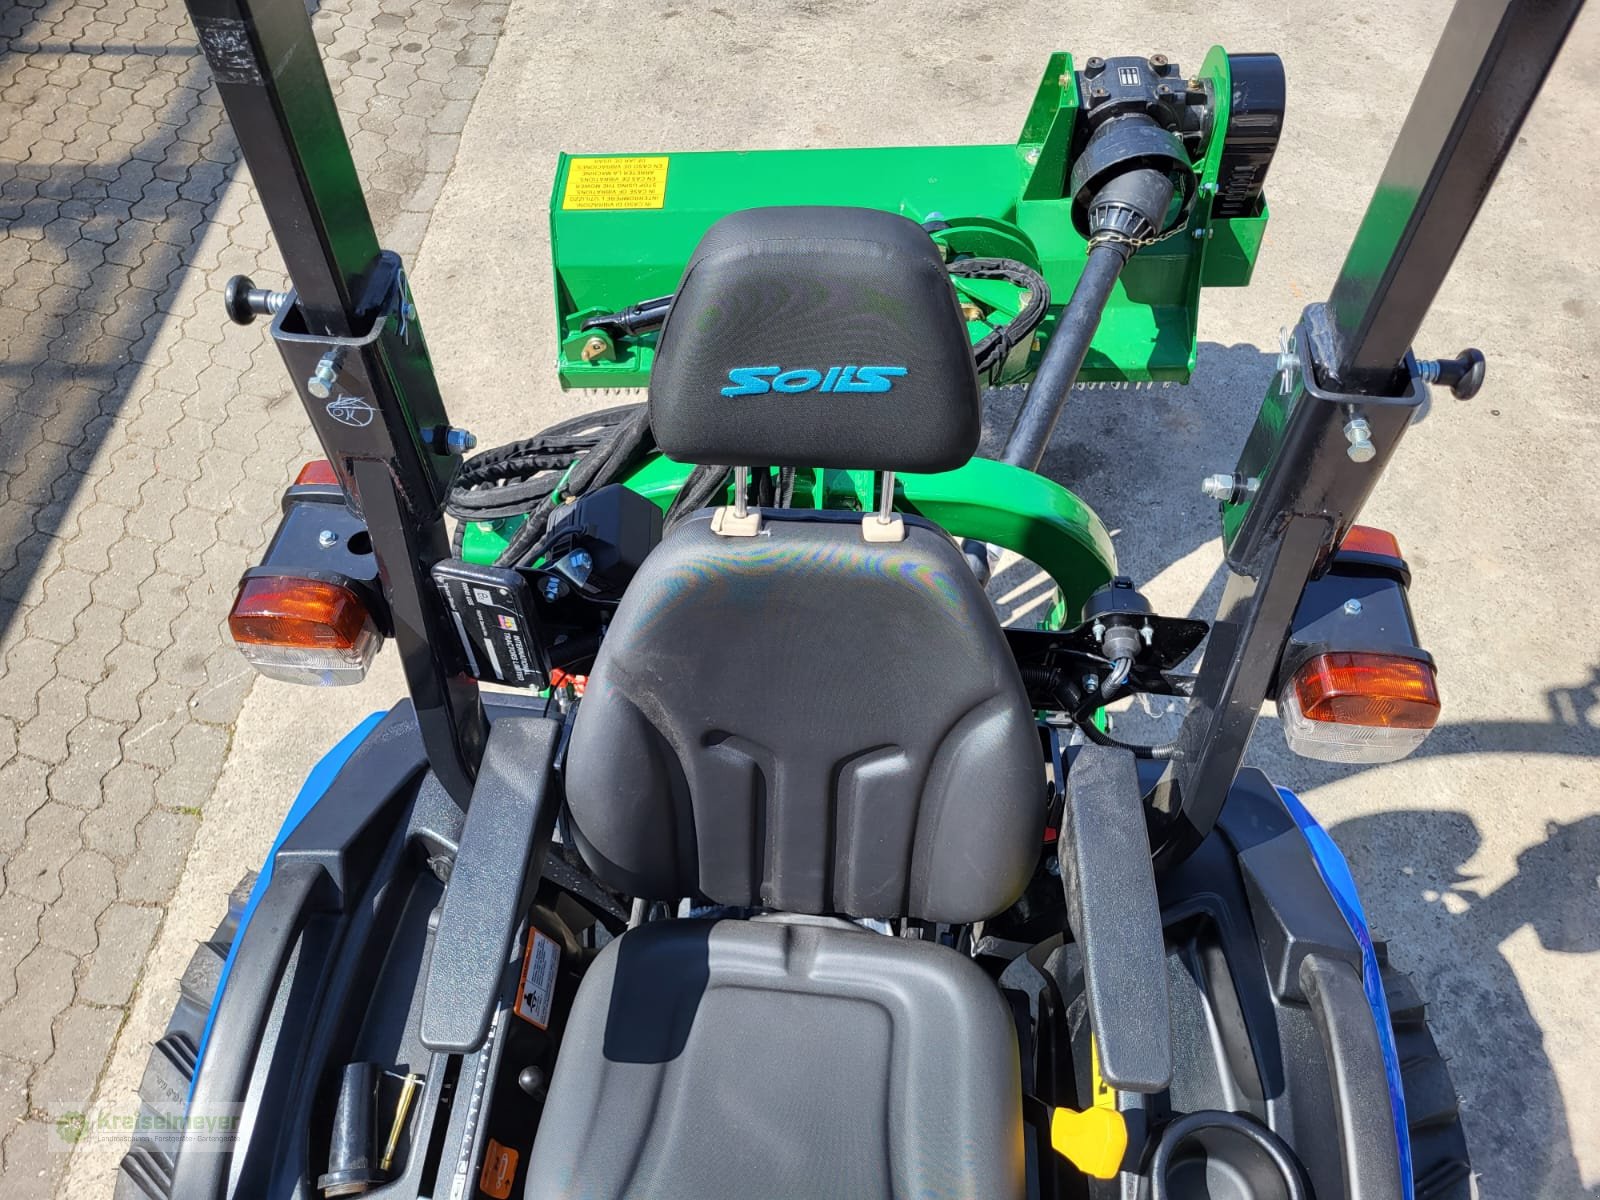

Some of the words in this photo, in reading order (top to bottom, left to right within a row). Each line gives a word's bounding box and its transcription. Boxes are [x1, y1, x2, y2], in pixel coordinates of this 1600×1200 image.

[504, 632, 518, 660] TRACTORS
[512, 661, 524, 680] LIMITED
[513, 635, 530, 675] INTERNATIONAL
